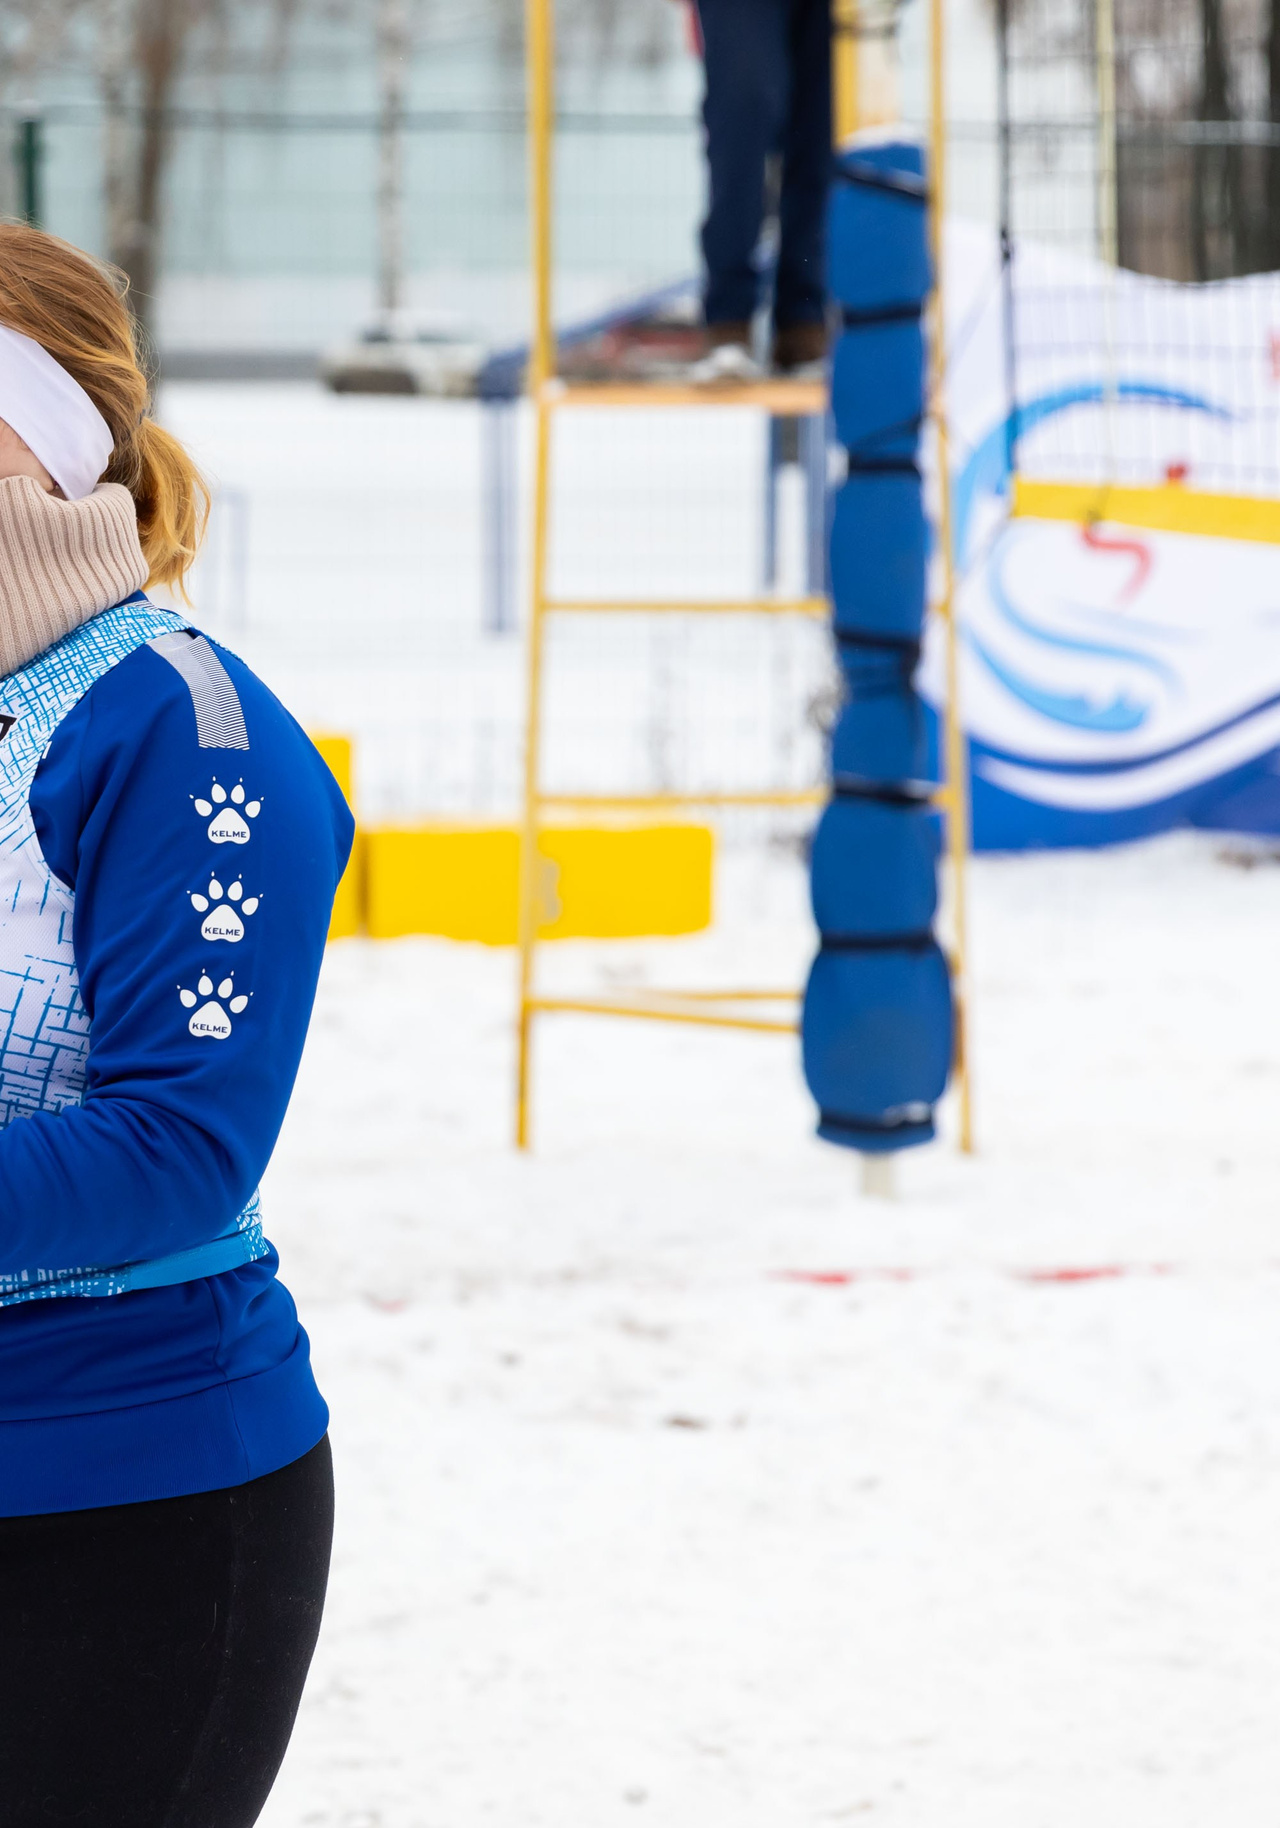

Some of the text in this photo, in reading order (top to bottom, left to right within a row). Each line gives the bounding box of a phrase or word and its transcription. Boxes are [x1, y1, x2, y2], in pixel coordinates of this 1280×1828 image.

[211, 829, 247, 839] KELME
[204, 926, 241, 937] KELME
[191, 1022, 228, 1034] KELME
